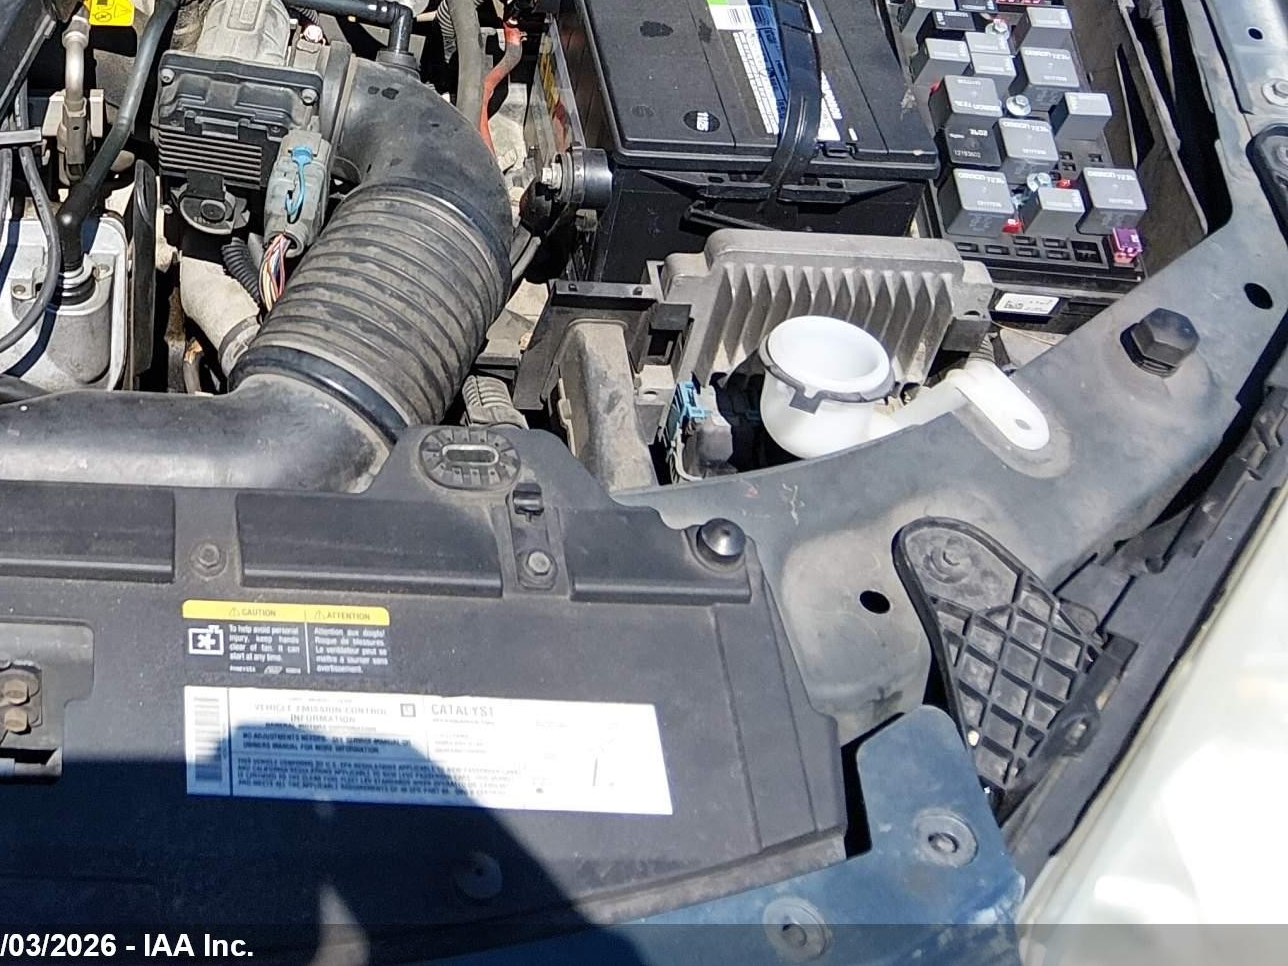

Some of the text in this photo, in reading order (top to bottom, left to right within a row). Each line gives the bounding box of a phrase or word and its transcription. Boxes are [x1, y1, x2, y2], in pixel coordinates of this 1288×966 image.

[242, 609, 277, 617] CAUTION
[326, 612, 370, 620] ATTENTION
[431, 703, 494, 718] CATALYST
